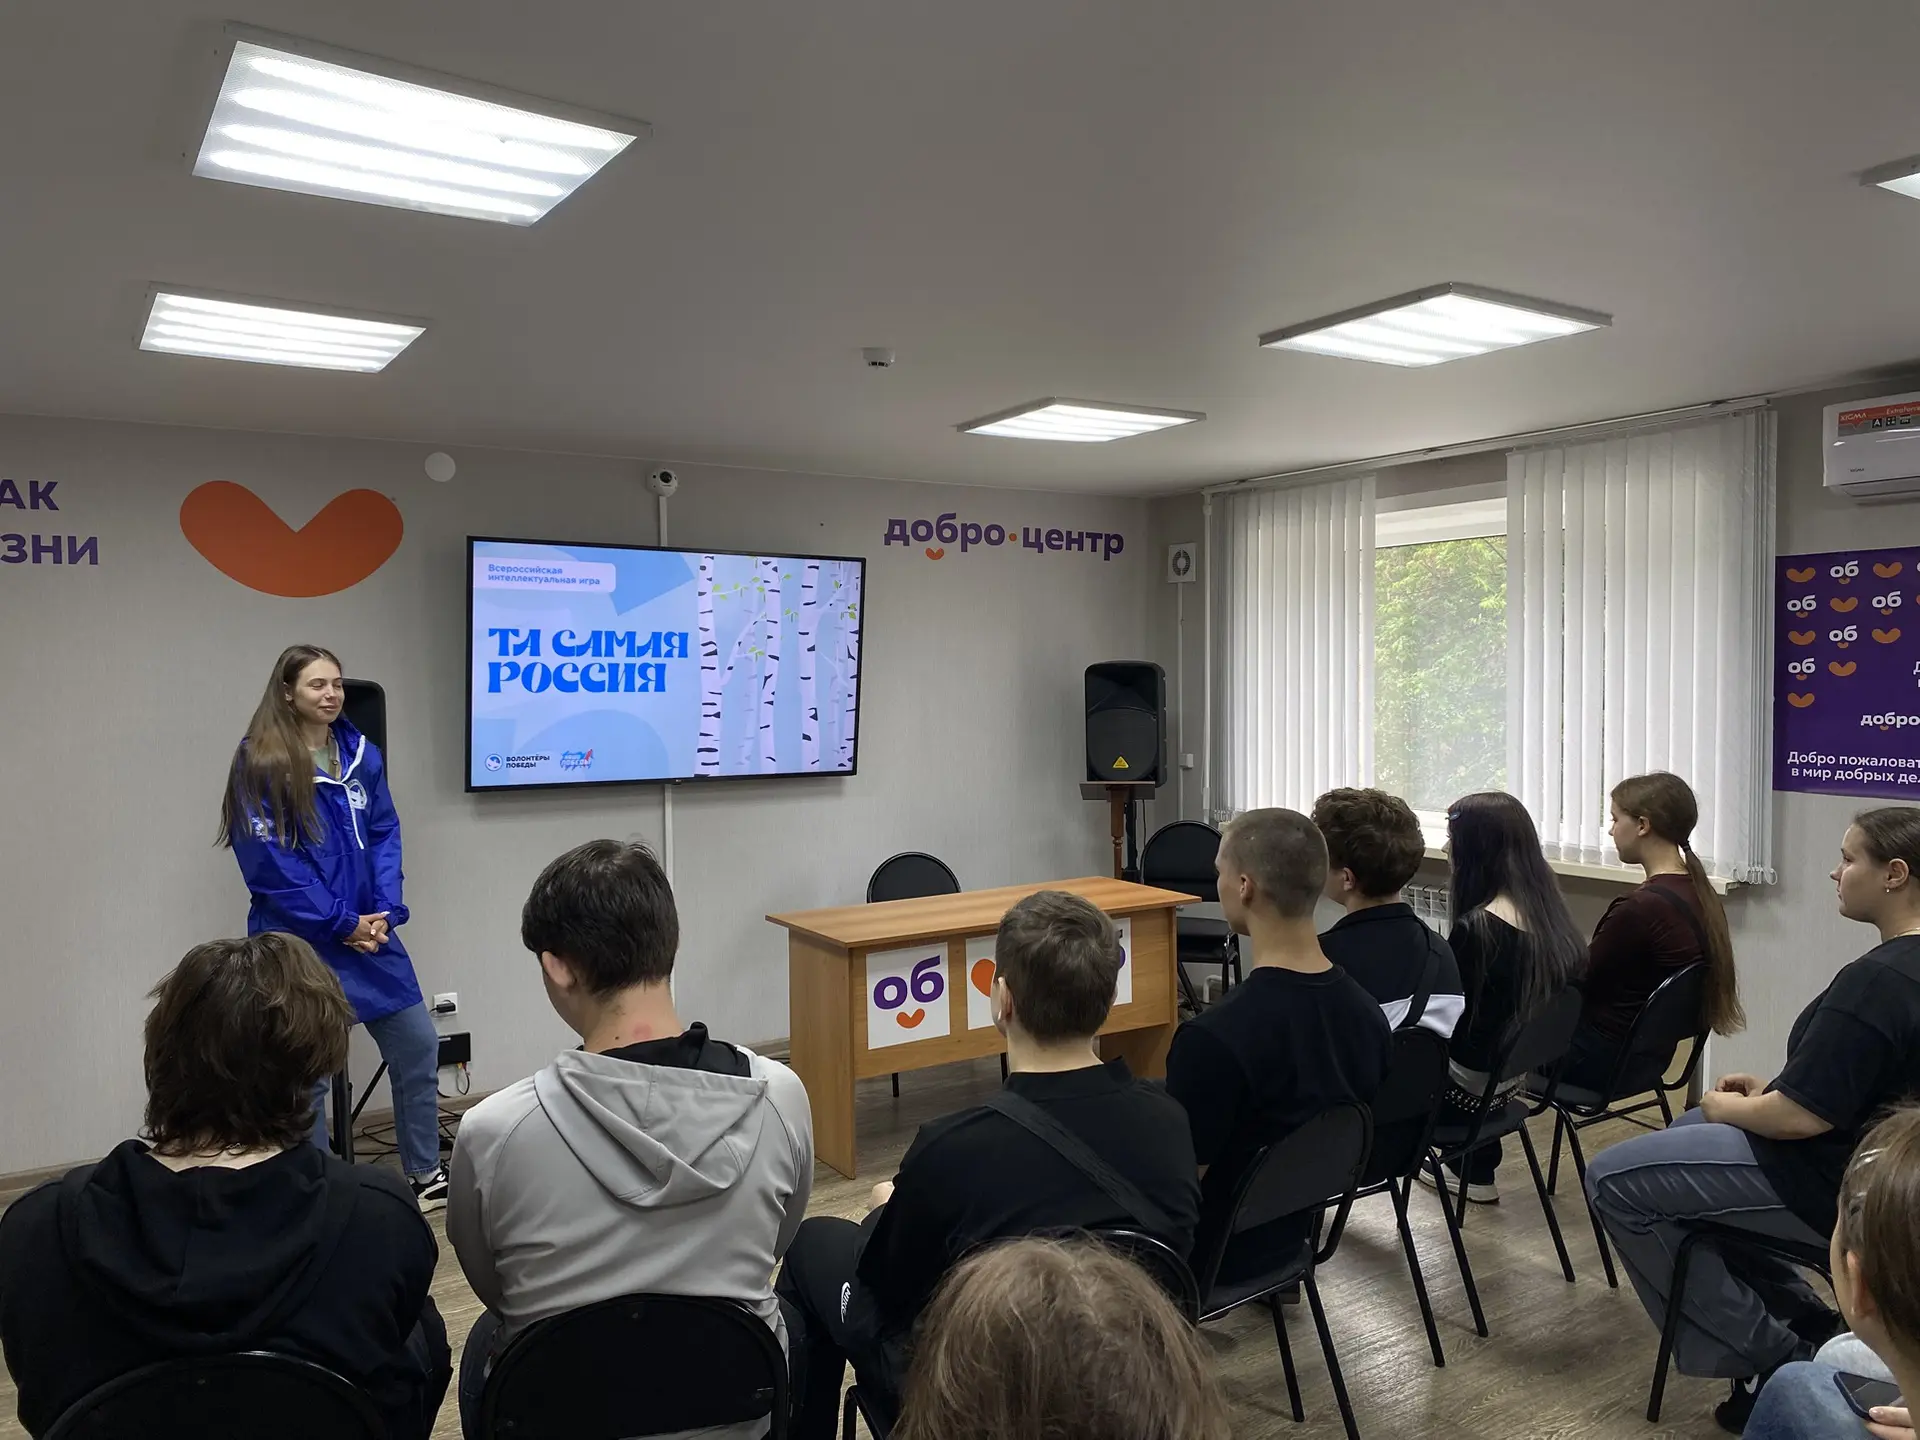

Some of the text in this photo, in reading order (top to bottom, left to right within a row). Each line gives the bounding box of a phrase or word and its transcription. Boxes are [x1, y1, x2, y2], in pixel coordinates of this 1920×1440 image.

[0, 479, 60, 511] АК
[0, 533, 98, 565] ЗНИ
[488, 564, 563, 575] Всероссийская
[1829, 560, 1859, 578] об
[488, 574, 600, 586] интеллектуальная игра
[1786, 594, 1817, 611] об
[1871, 590, 1902, 608] об
[1828, 625, 1858, 642] об
[488, 628, 689, 658] ТА САМАЯ
[1787, 657, 1816, 674] об
[488, 661, 667, 693] РОССИЯ
[1787, 751, 1836, 766] Добро
[1791, 767, 1799, 776] в
[1802, 768, 1832, 781] мир
[1834, 768, 1895, 783] добрых
[873, 955, 944, 1010] об
